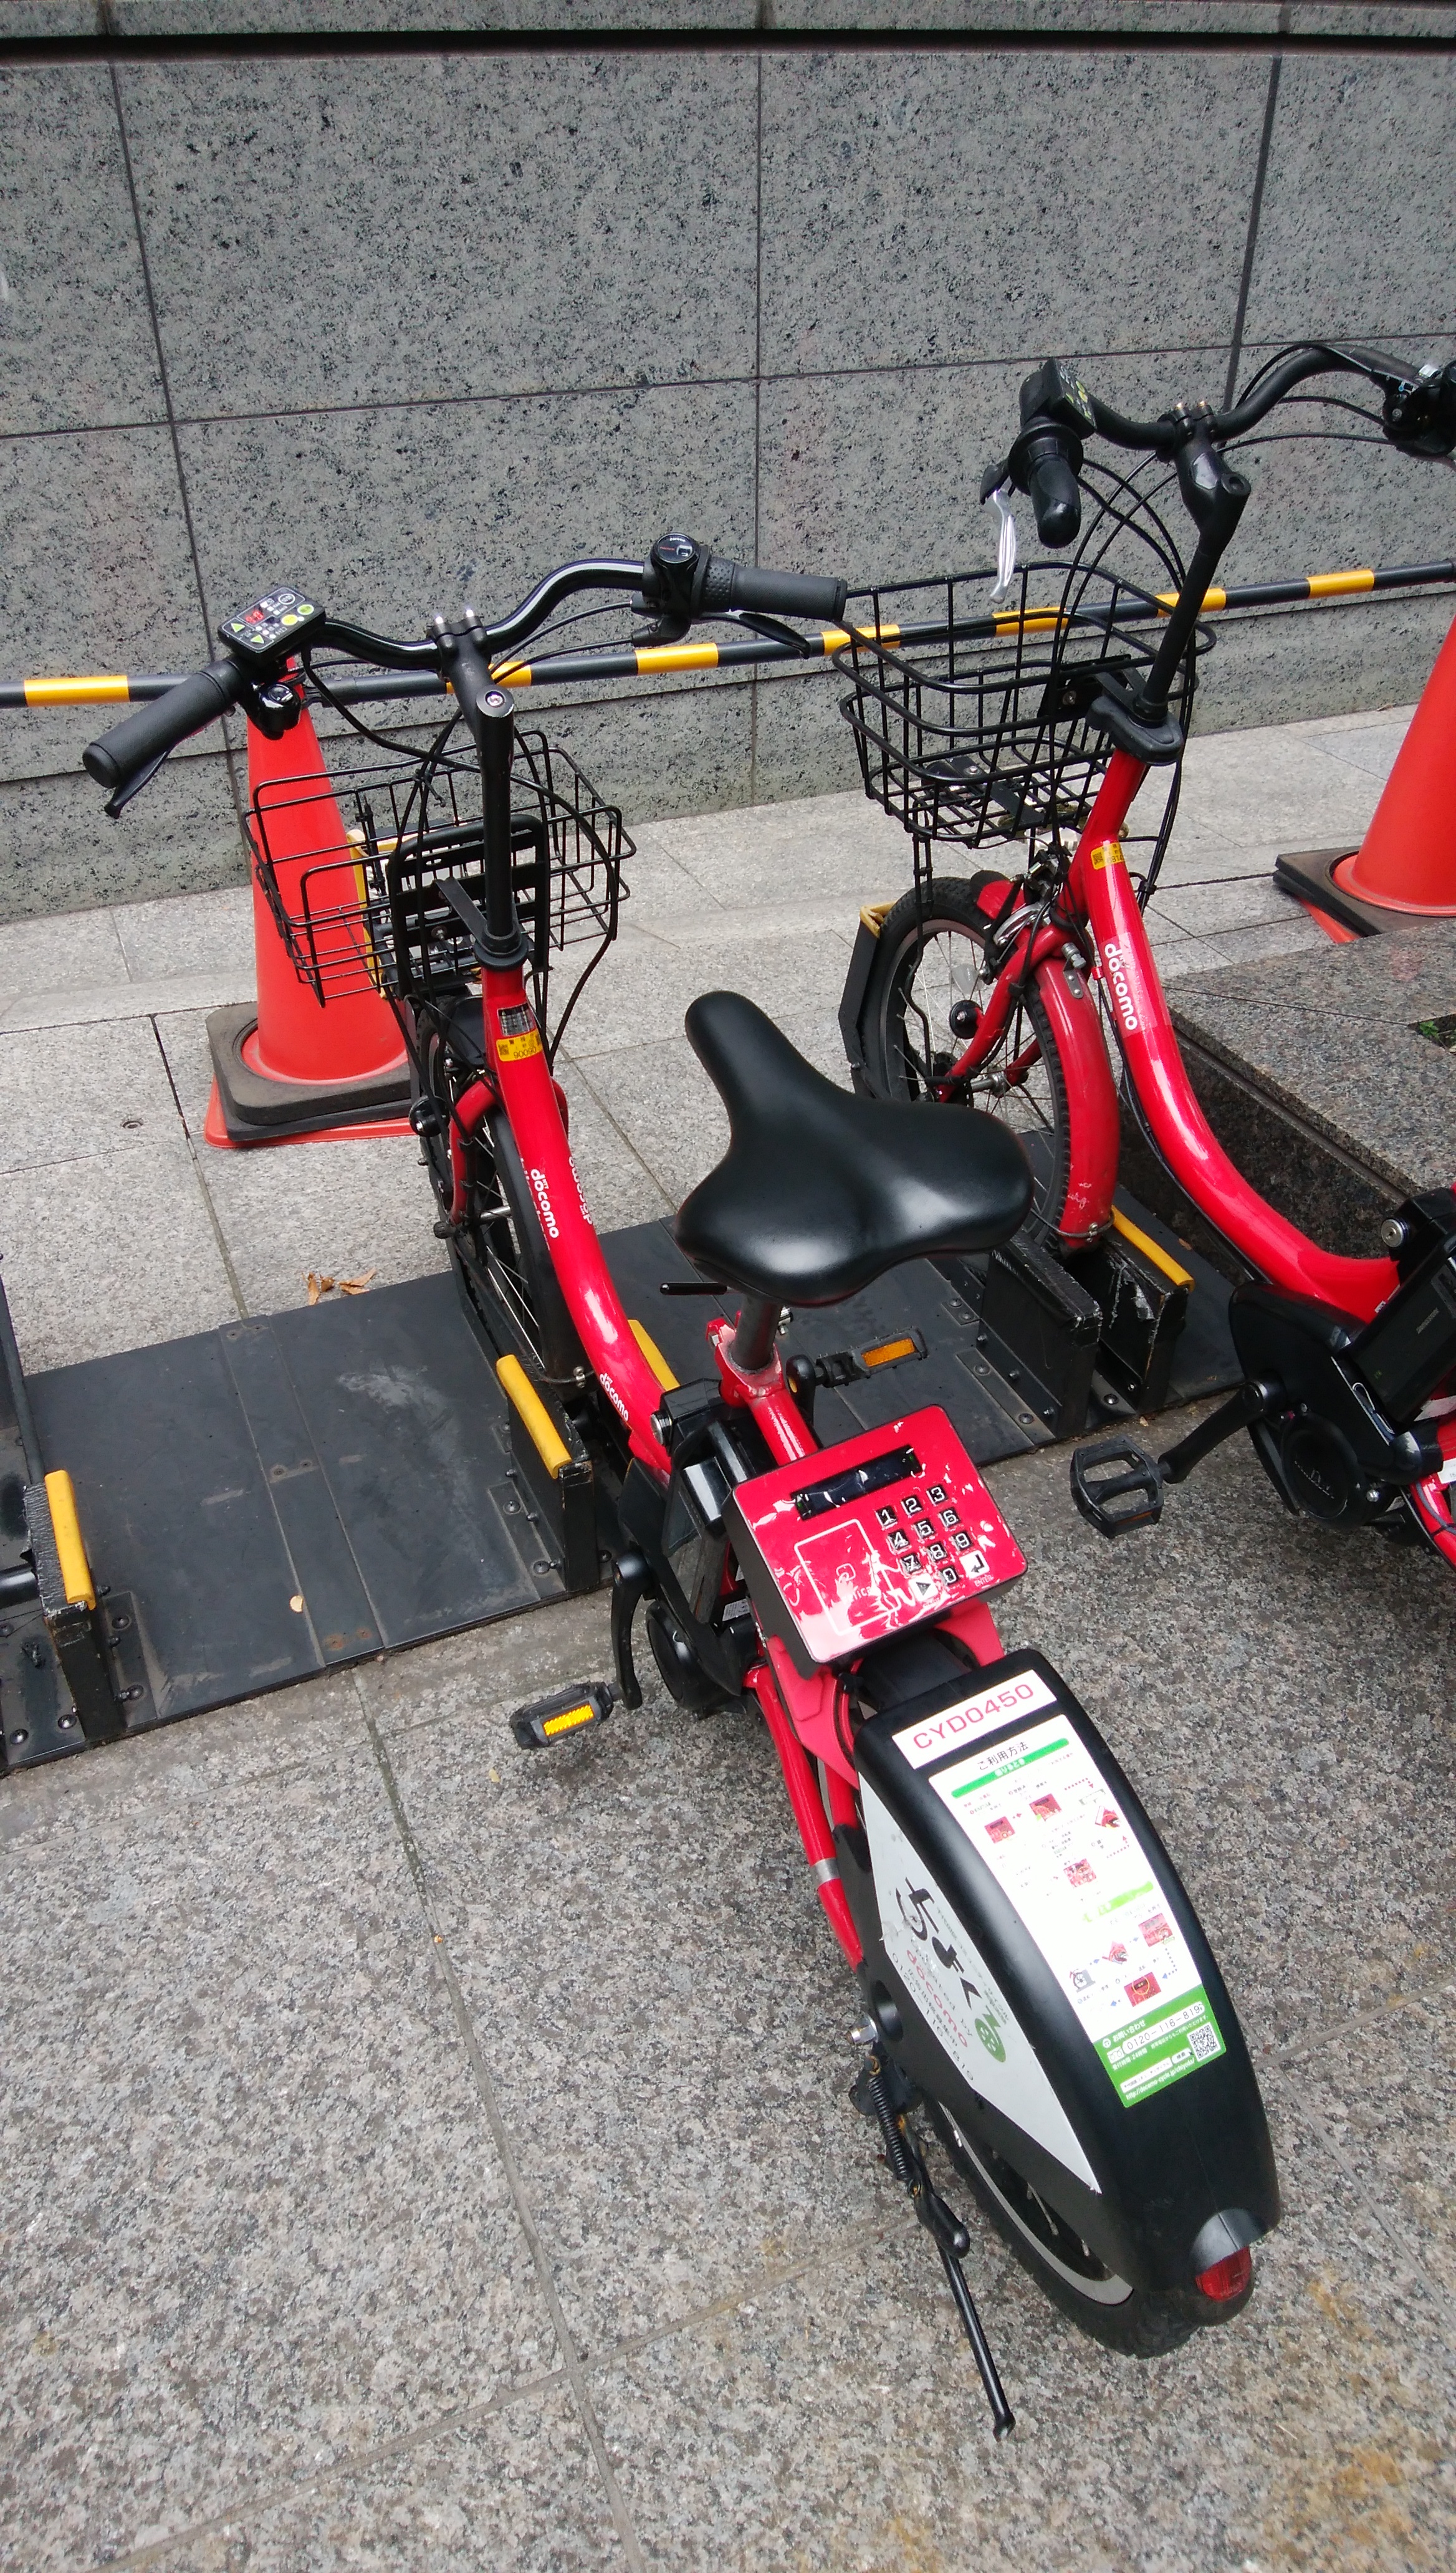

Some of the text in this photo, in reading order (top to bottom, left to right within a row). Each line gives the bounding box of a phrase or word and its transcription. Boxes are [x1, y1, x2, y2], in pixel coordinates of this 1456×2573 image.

[1104, 943, 1138, 1030] docomo
[530, 1169, 560, 1239] docomo
[600, 1373, 628, 1421] docomo
[881, 1487, 946, 1525] 1 2 3
[893, 1510, 957, 1548] 4 5 6
[931, 1544, 946, 1560] 8
[956, 1532, 970, 1547] 9
[913, 1684, 1034, 1749] CYD0450
[907, 1949, 968, 2048] docomo
